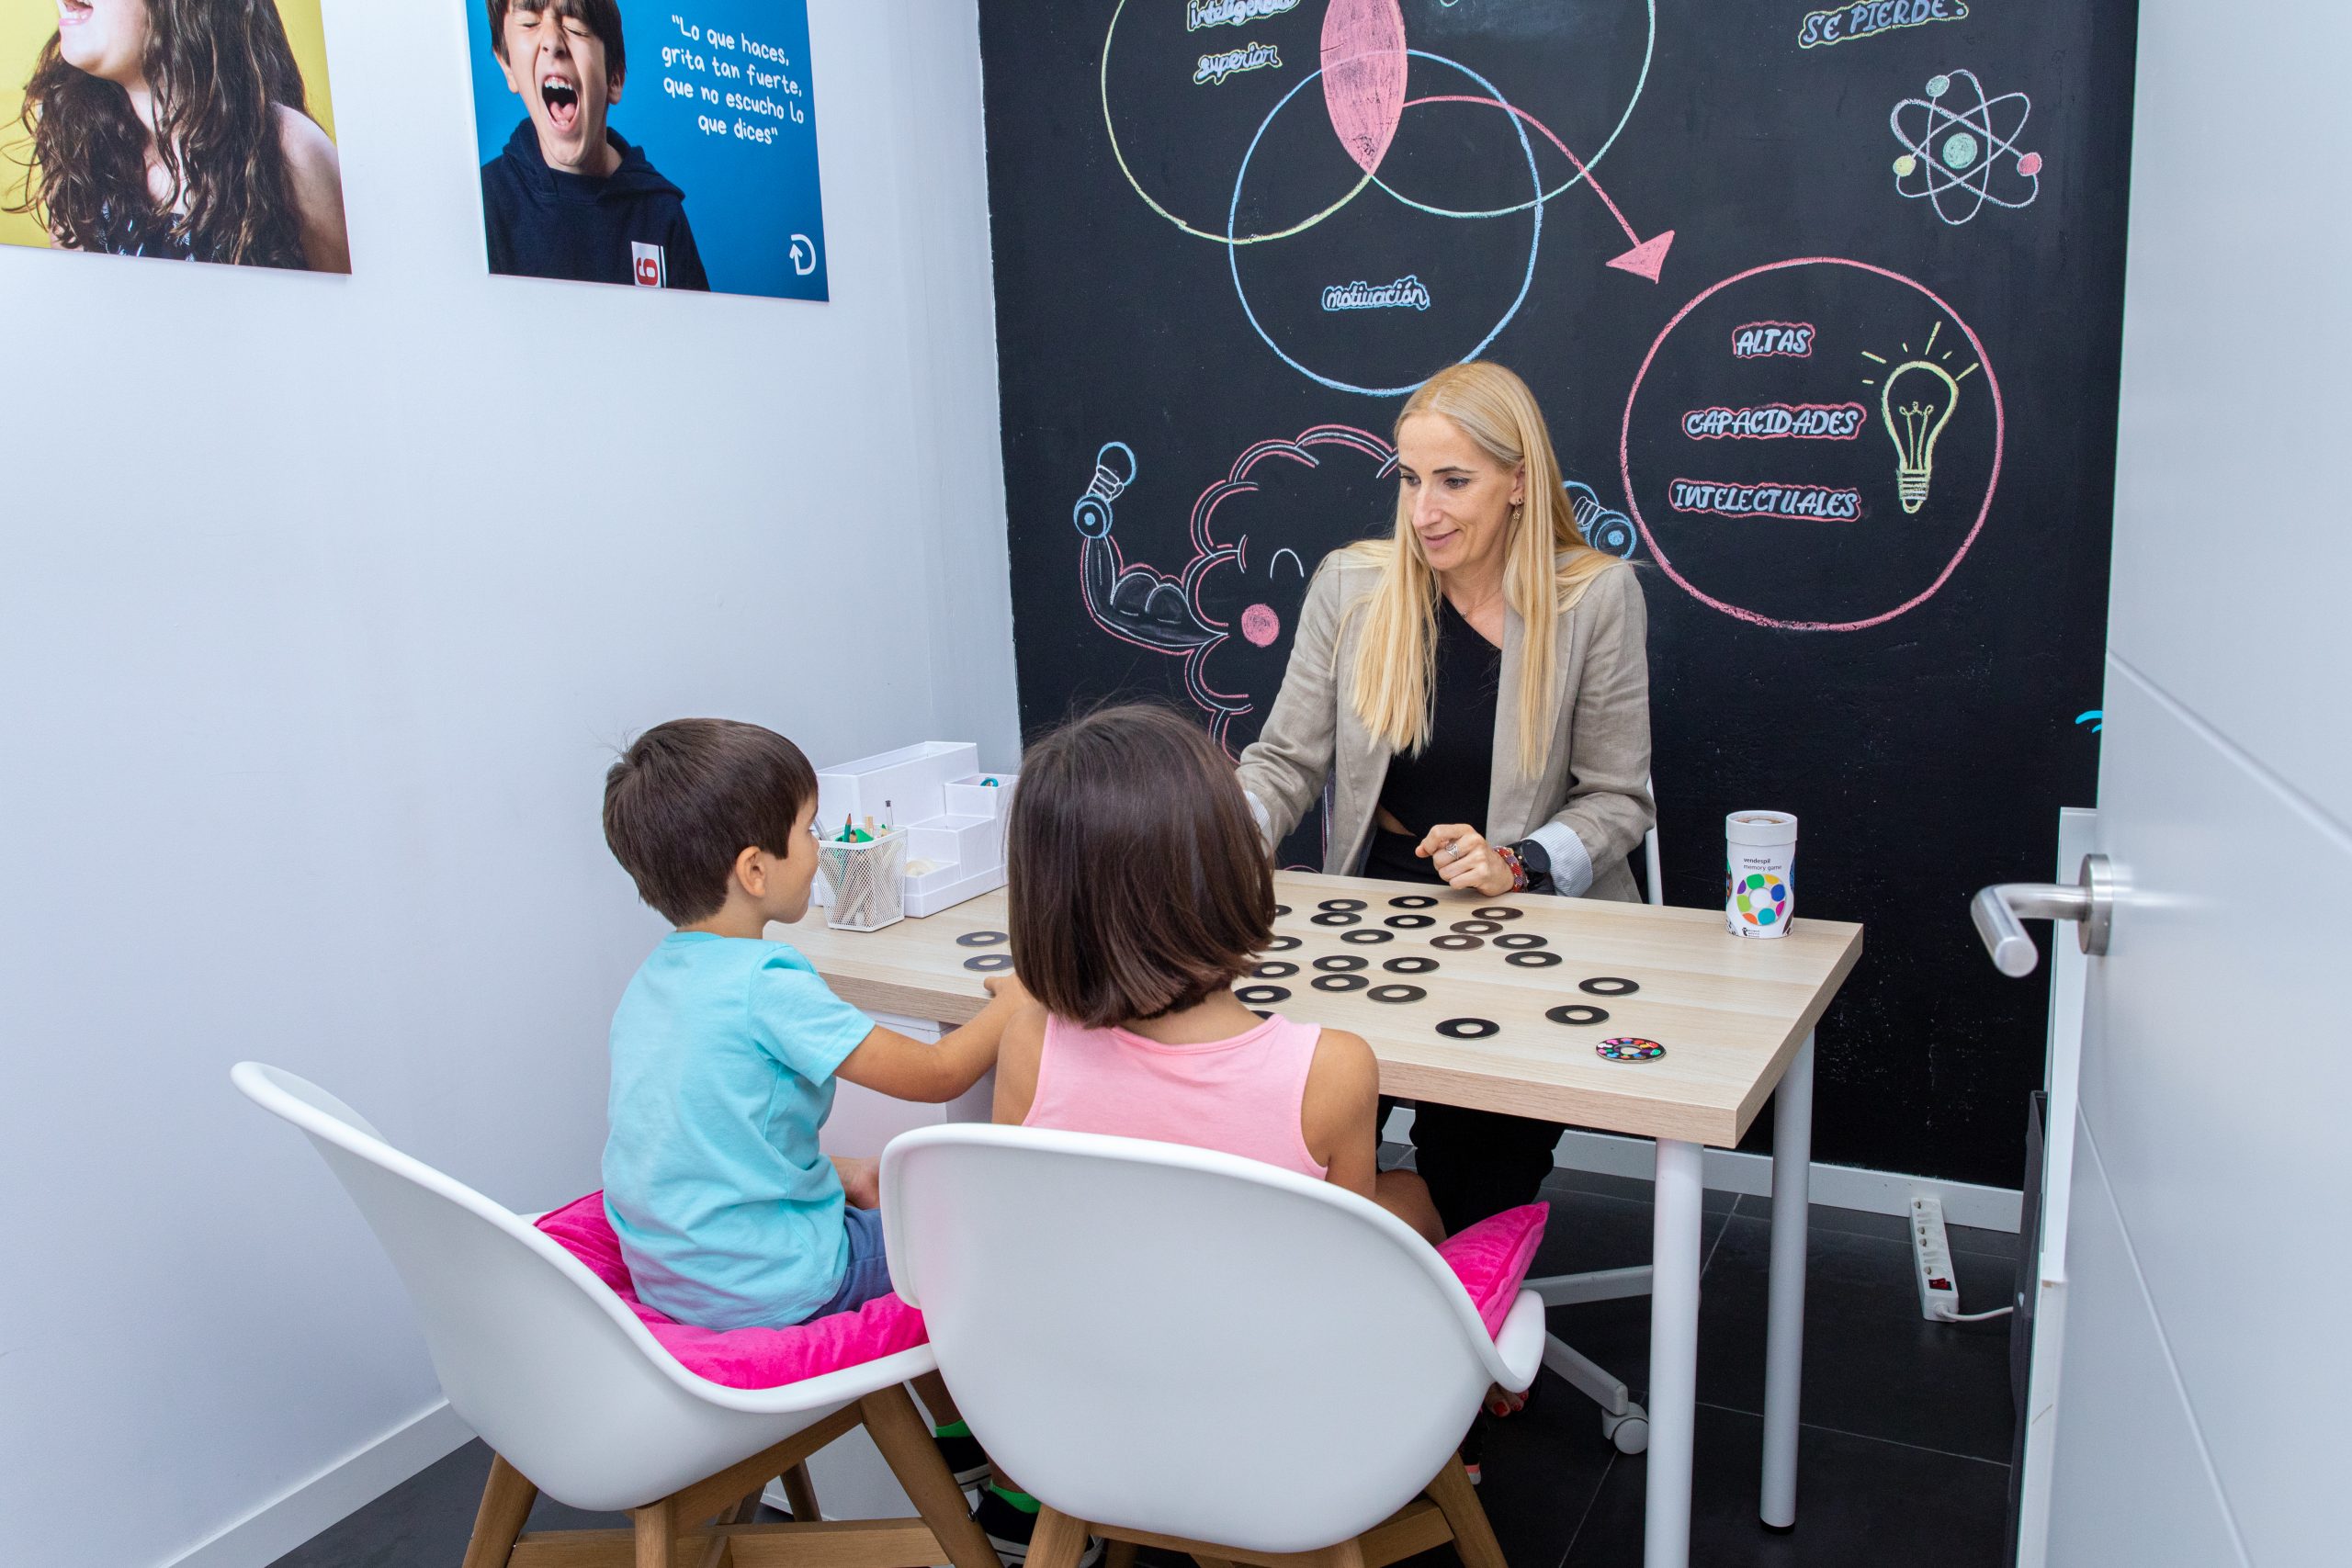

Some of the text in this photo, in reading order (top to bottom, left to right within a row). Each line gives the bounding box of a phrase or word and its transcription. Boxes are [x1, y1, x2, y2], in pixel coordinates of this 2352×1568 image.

[672, 14, 789, 66] "Lo que haces,
[1803, 14, 1842, 43] SE
[662, 46, 802, 97] grita tan fuerte,
[1196, 44, 1278, 80] superior
[663, 76, 804, 124] que no escucho lo
[698, 115, 779, 145] que dices"
[1327, 281, 1427, 309] motivación
[1736, 328, 1811, 355] ALTAS
[1685, 408, 1860, 436] CAPACIDADES
[1674, 483, 1859, 518] INTELECTUALES
